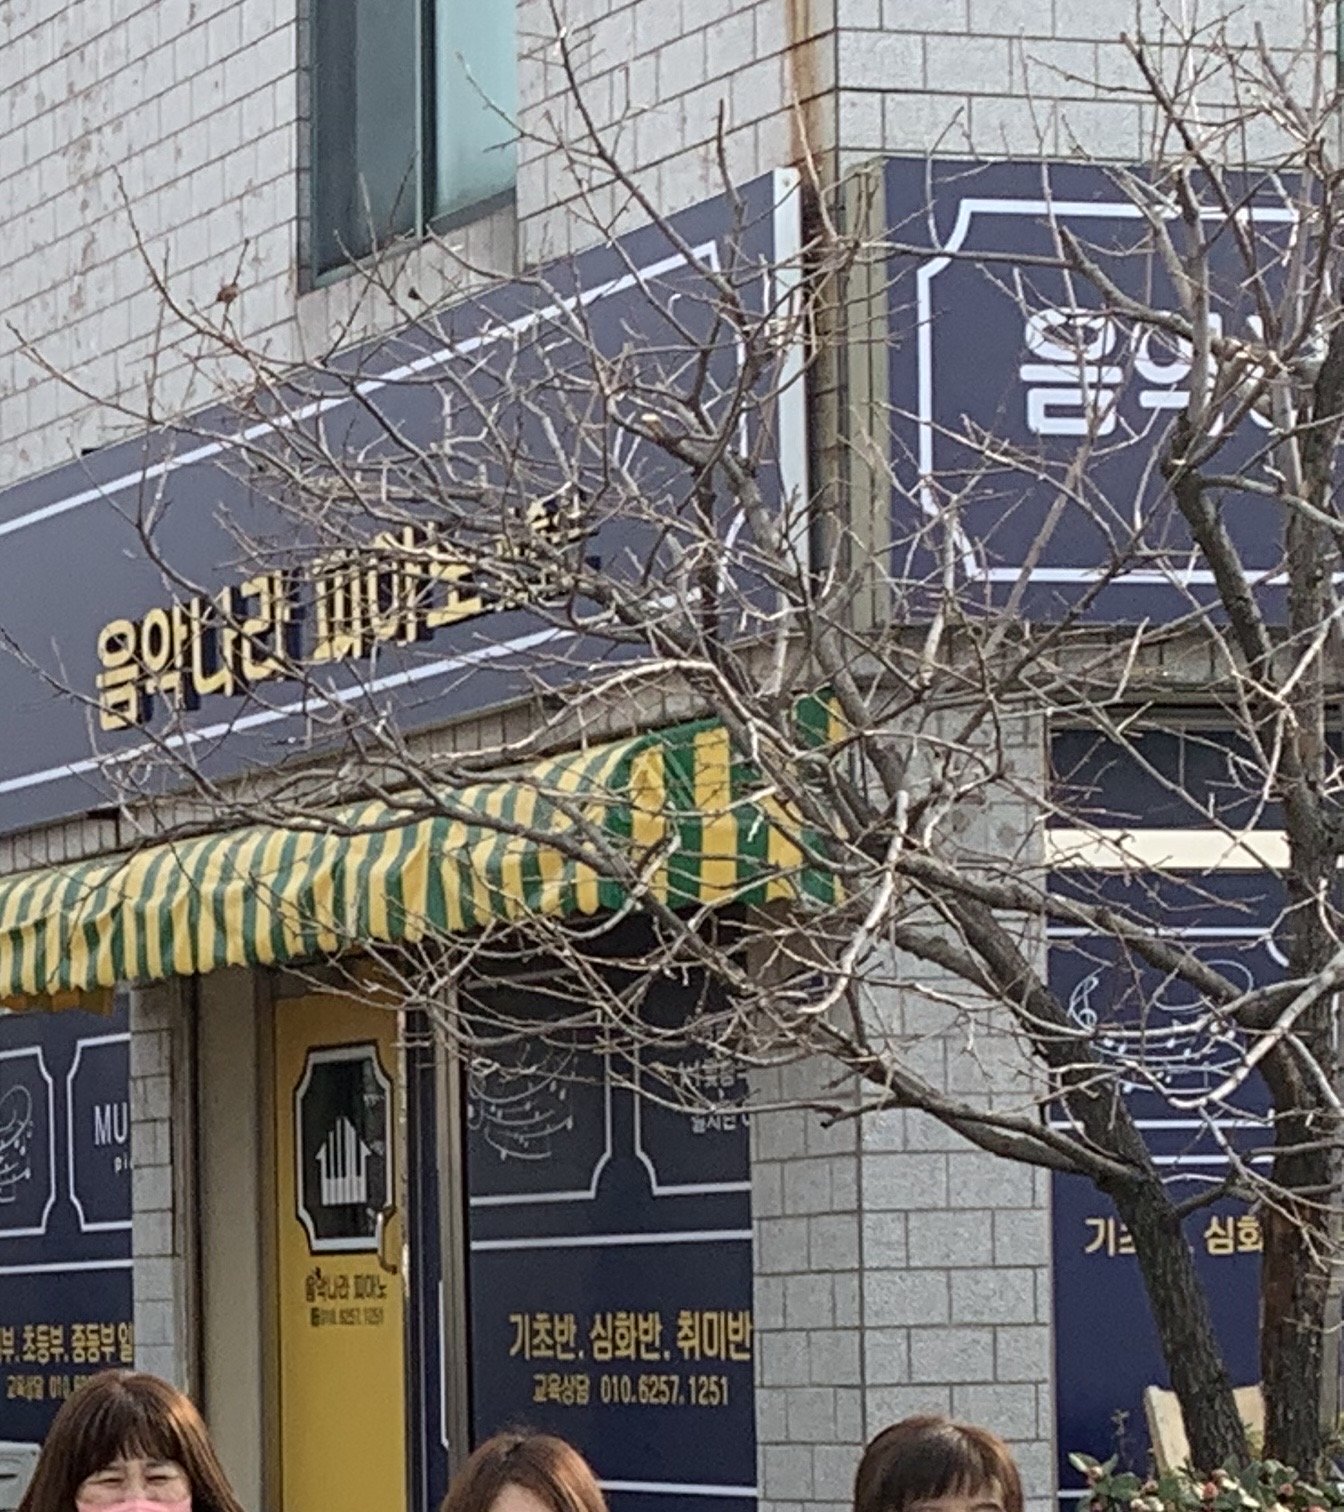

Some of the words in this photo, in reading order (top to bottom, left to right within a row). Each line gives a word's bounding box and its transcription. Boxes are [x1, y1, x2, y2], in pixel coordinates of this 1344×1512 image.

[96, 569, 290, 730] 음악나라
[314, 522, 482, 660] 피아노
[94, 1102, 128, 1146] MU
[509, 1312, 585, 1361] 기초반.
[588, 1312, 671, 1362] 심화반.
[676, 1310, 753, 1362] 취미반
[531, 1373, 590, 1406] 교육상담
[600, 1374, 729, 1407] 010.6257.1251
